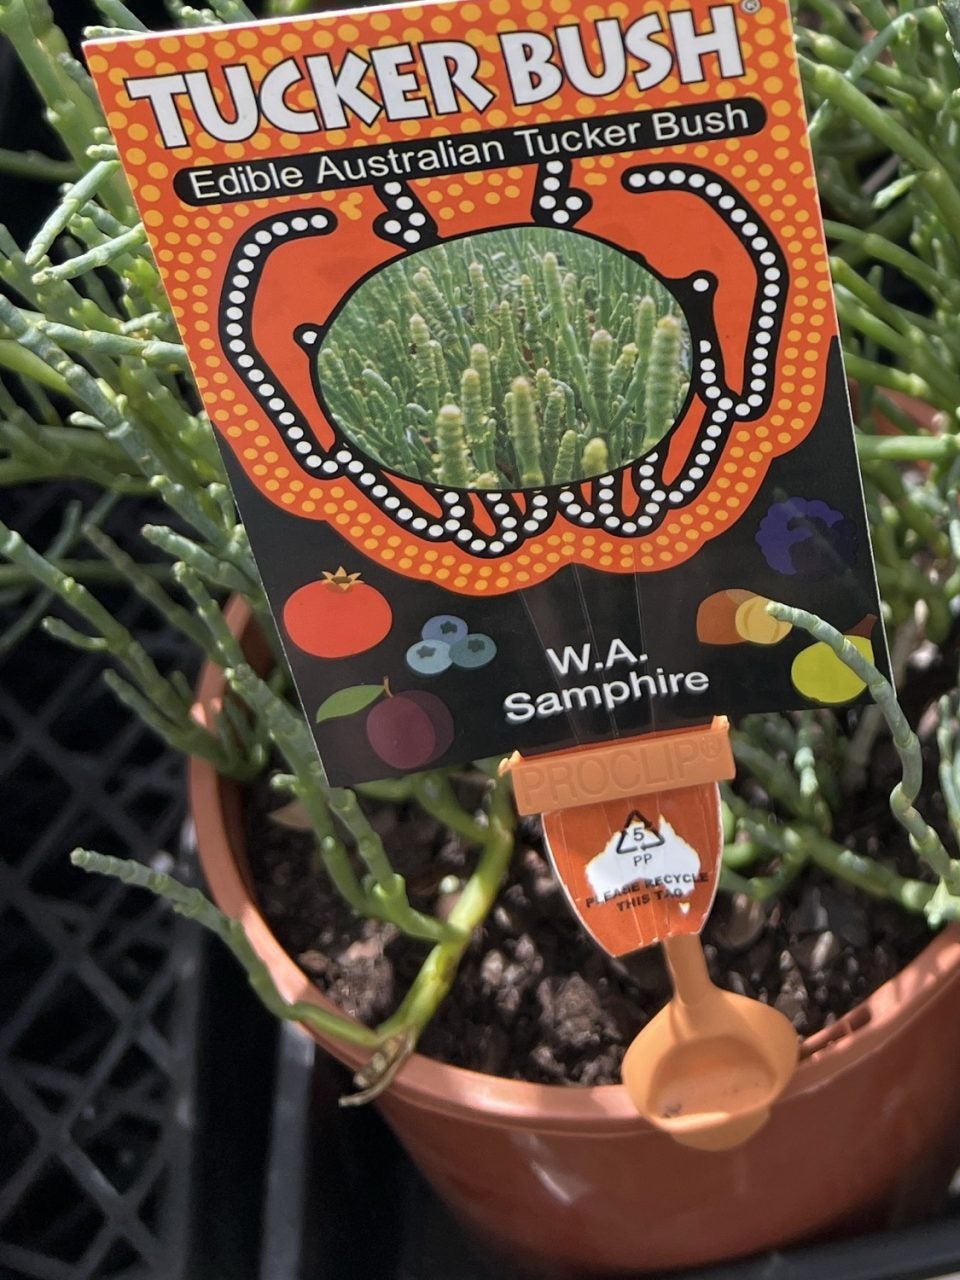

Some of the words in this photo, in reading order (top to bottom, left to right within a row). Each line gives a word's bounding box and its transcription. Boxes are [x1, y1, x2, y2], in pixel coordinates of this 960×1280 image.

[124, 39, 496, 150] TUCKER
[187, 162, 303, 200] Edible
[316, 138, 504, 185] Australian
[513, 118, 642, 159] Tucker
[651, 100, 750, 140] Bush
[546, 637, 649, 676] W.A.
[503, 667, 710, 723] Samphire
[633, 853, 653, 868] PP
[585, 881, 640, 908] PLEASE
[644, 872, 709, 889] RECYCLE
[616, 894, 651, 911] THIS
[655, 888, 684, 901] TAG
